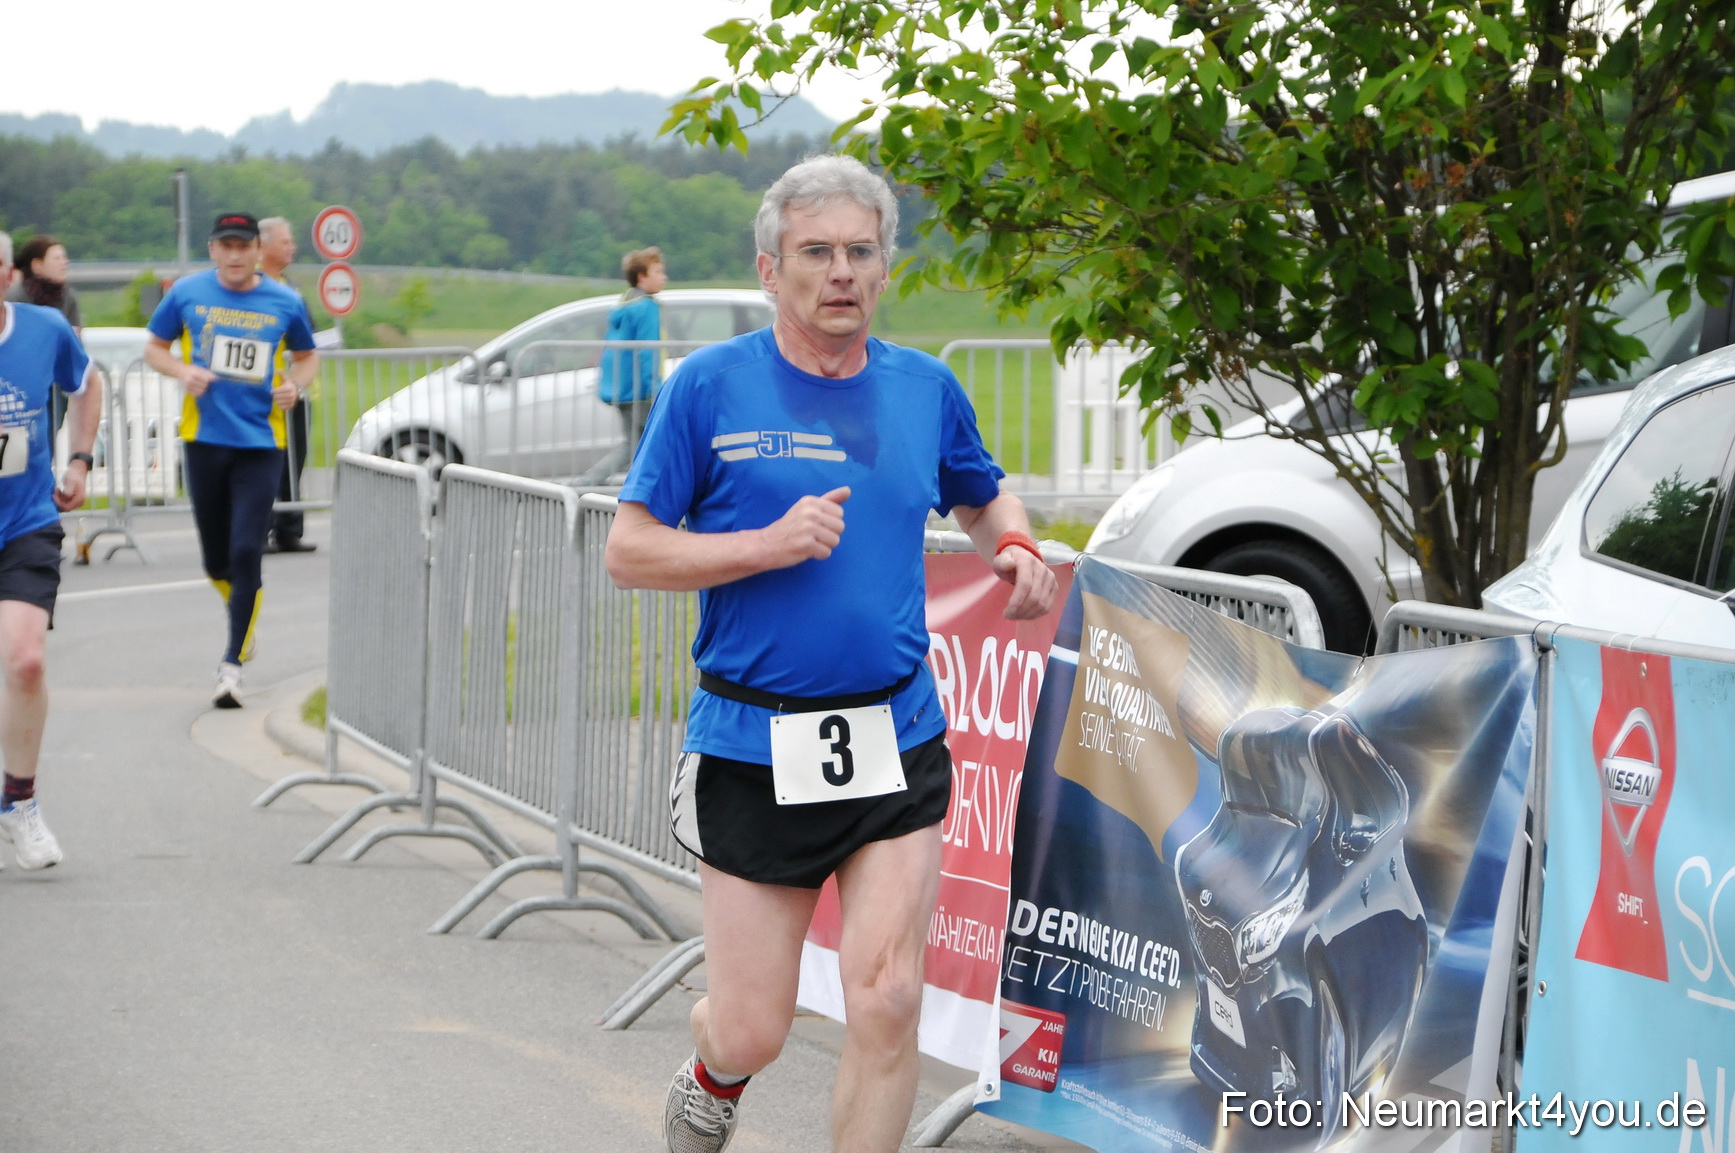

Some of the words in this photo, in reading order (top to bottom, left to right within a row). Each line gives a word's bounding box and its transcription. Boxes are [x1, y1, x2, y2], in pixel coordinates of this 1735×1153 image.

[324, 221, 348, 245] 60
[206, 314, 263, 330] STADTLAUF
[209, 306, 277, 326] NEUMARKTER
[225, 341, 257, 371] 119
[819, 714, 854, 787] 3
[1605, 767, 1655, 797] NISSAN
[1011, 899, 1078, 948] DER
[1110, 929, 1139, 972] KIA
[1140, 940, 1181, 989] CEE'D.
[1001, 942, 1081, 994] JETZT
